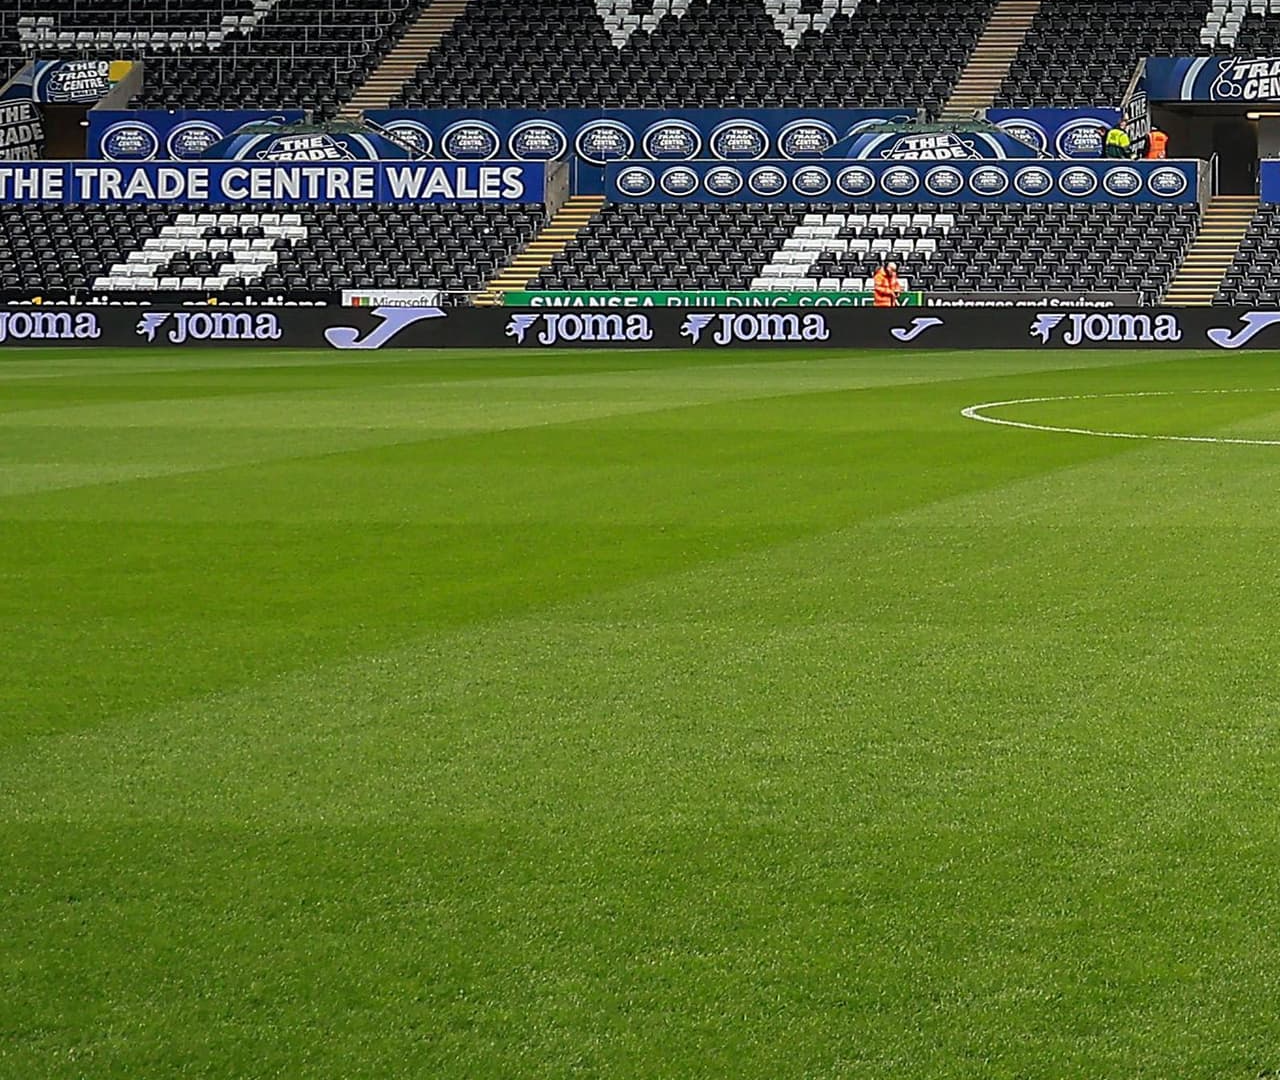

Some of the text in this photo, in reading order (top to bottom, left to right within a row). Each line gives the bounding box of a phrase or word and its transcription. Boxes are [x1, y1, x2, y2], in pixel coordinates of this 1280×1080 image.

[67, 61, 96, 71] THE
[63, 78, 104, 91] CENTRE
[280, 137, 322, 150] THE
[905, 135, 949, 150] THE
[0, 167, 523, 200] THE TRADE CENTRE WALES
[373, 297, 429, 307] Microsoft
